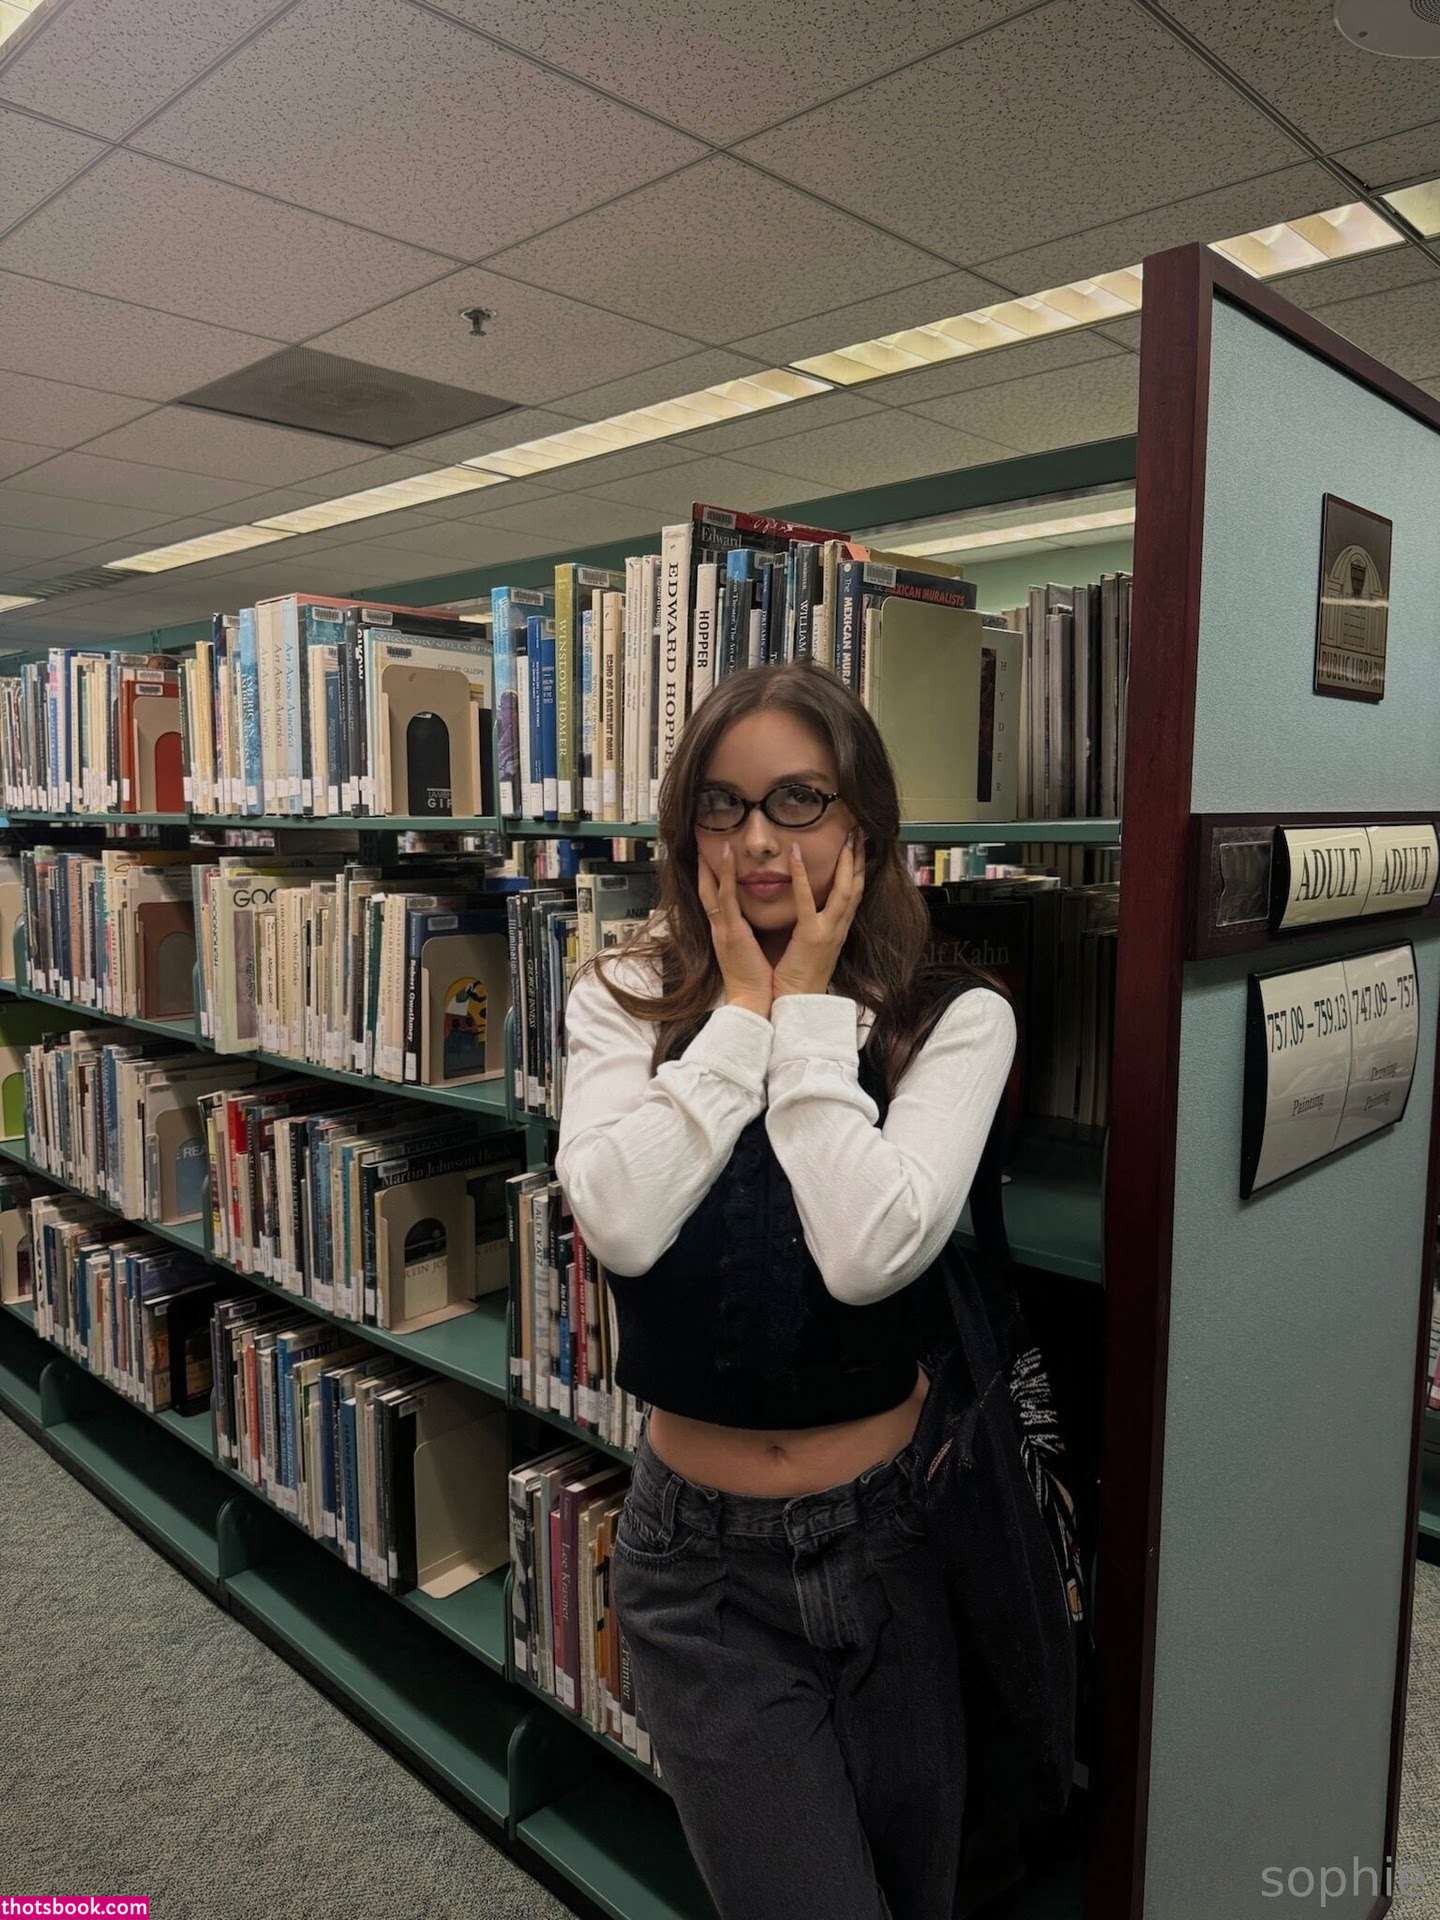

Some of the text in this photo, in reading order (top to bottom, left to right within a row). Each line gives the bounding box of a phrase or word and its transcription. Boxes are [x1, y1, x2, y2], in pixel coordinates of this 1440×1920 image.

[702, 526, 742, 548] Edward
[667, 562, 679, 673] EDWARD
[798, 600, 809, 651] WILLIAM
[842, 596, 852, 652] MEXICAN
[273, 642, 283, 663] Art
[283, 641, 294, 661] Art
[698, 610, 710, 668] HOPPER
[606, 654, 614, 677] ECHO
[606, 678, 614, 690] OF
[1319, 651, 1385, 688] PUBLIC LIBRARY
[246, 673, 256, 738] AMERICAN
[558, 619, 568, 760] WINSLOW HOMER
[606, 690, 614, 699] A
[275, 705, 285, 748] America
[287, 704, 296, 748] America
[606, 700, 614, 735] DISTANT
[1295, 847, 1362, 902] ADULT
[1376, 846, 1432, 896] ADULT
[508, 919, 518, 975] Illumination
[952, 939, 1009, 965] Kahn
[291, 961, 300, 987] Gorky
[526, 959, 536, 995] GEORGE
[406, 959, 417, 1043] Robert Gwathmey
[1292, 1094, 1325, 1117] Painting
[246, 1113, 255, 1153] WILLIAM
[290, 1131, 301, 1233] MARSDEN HARTLEY
[382, 1166, 425, 1188] Martin
[426, 1155, 480, 1180] Johnson
[536, 1239, 544, 1267] KATZ
[560, 1283, 569, 1317] Alex Katz
[343, 1423, 351, 1465] HANS
[560, 1542, 572, 1621] Lee Krasner
[622, 1649, 632, 1700] Painter
